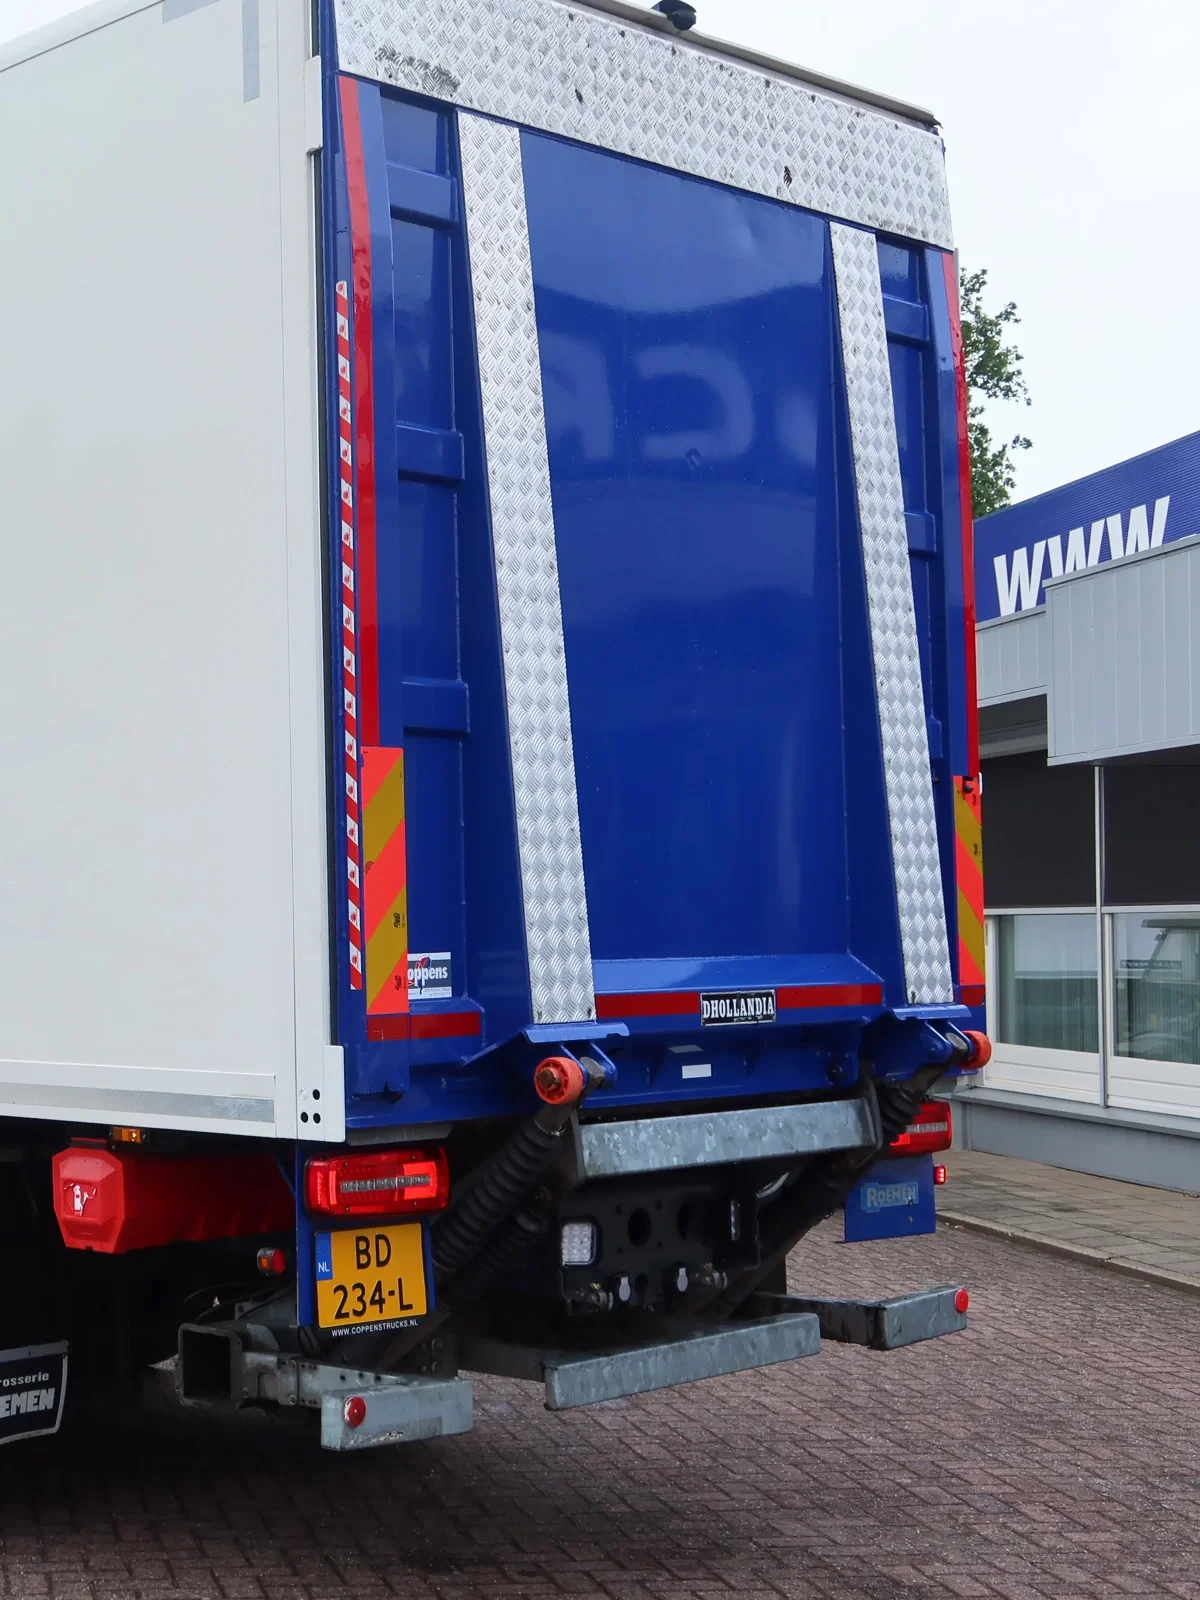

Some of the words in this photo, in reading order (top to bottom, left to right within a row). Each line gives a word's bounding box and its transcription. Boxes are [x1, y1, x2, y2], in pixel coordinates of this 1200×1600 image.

[407, 966, 449, 987] oppens
[702, 997, 775, 1019] DHOLLANDIA
[866, 1184, 917, 1208] ROEMEN
[355, 1233, 392, 1270] BD
[318, 1261, 330, 1272] NL
[333, 1278, 414, 1320] 234-L
[331, 1319, 419, 1337] WWW.COPPENSTRUCKS.NL
